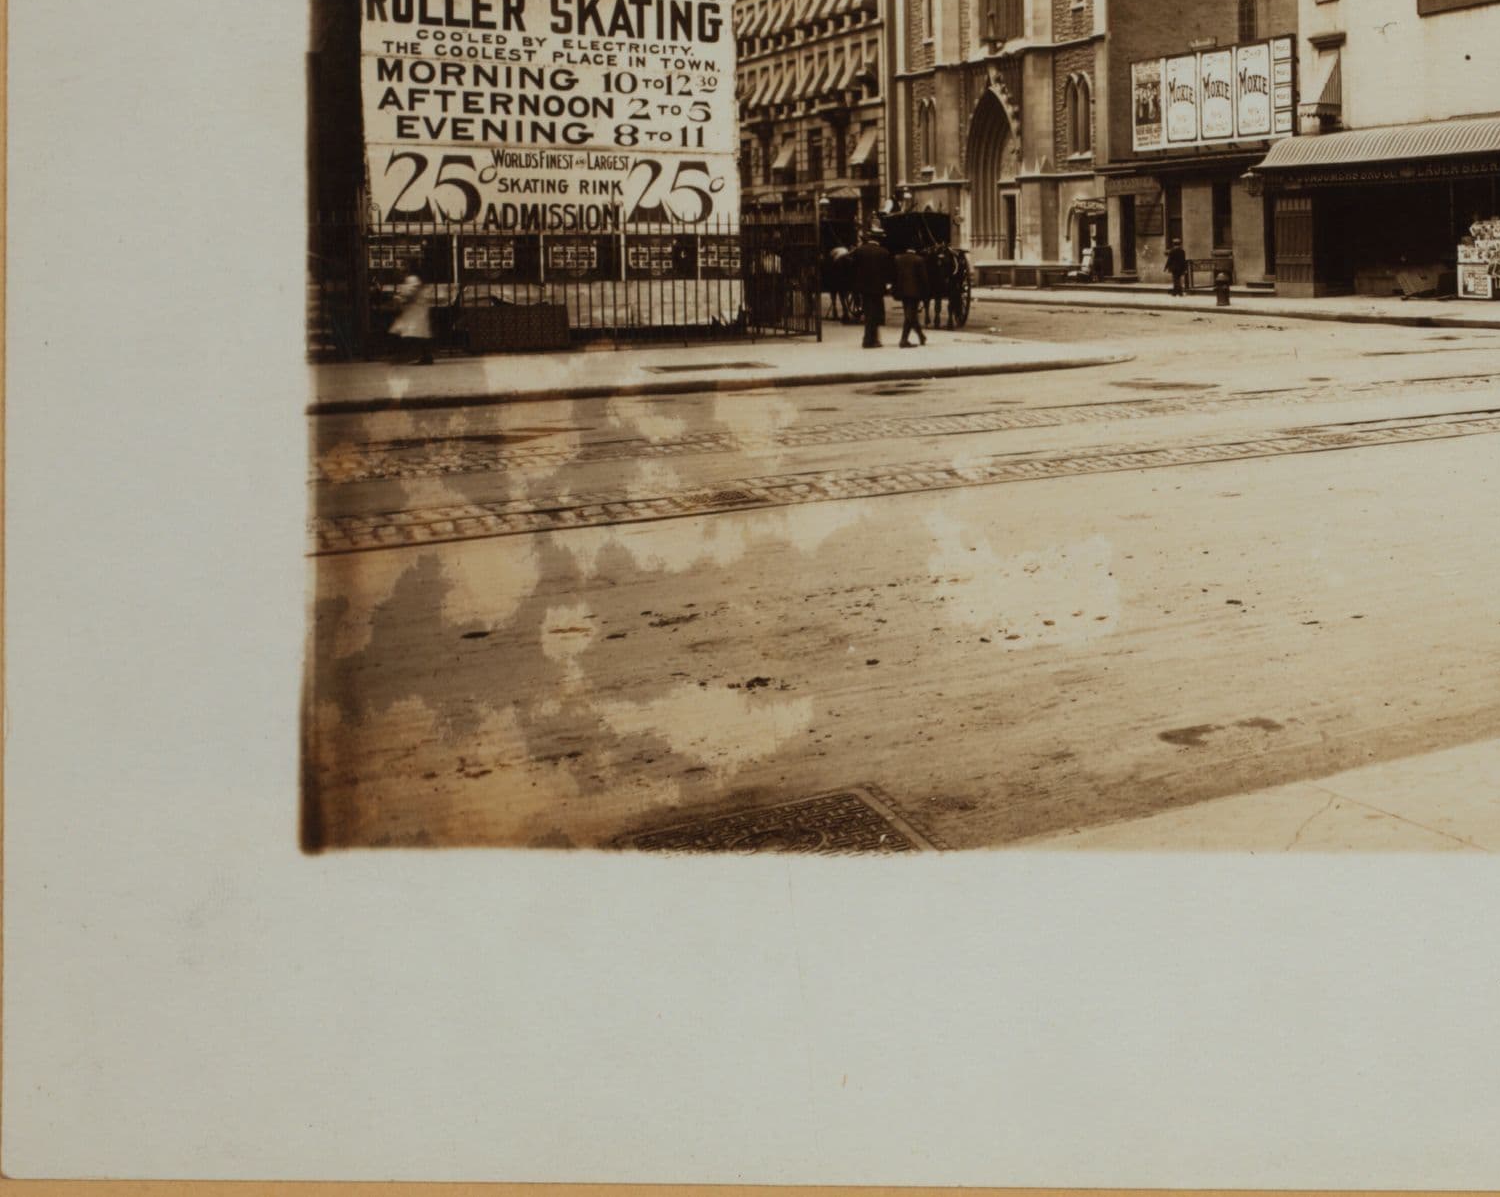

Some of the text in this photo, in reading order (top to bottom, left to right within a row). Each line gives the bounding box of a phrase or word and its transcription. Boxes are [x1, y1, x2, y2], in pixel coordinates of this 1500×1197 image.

[382, 40, 721, 73] THE COOLEST PLACE IN TOWN.
[416, 29, 695, 56] COOLED BY ELECTRICITY.
[377, 57, 579, 91] MORNING
[602, 71, 638, 94] 10
[642, 78, 664, 89] TO
[1203, 72, 1230, 102] MOXIE
[1239, 67, 1268, 100] MOXIE
[378, 86, 712, 122] AFTERNOON 2 TO 5
[1168, 76, 1194, 107] MOXIE
[396, 115, 704, 148] EVENING 8 TO 11
[539, 150, 574, 170] FINEST
[587, 151, 629, 171] LARGEST
[498, 178, 624, 196] SKATING RINK
[482, 202, 620, 231] ADMISSION
